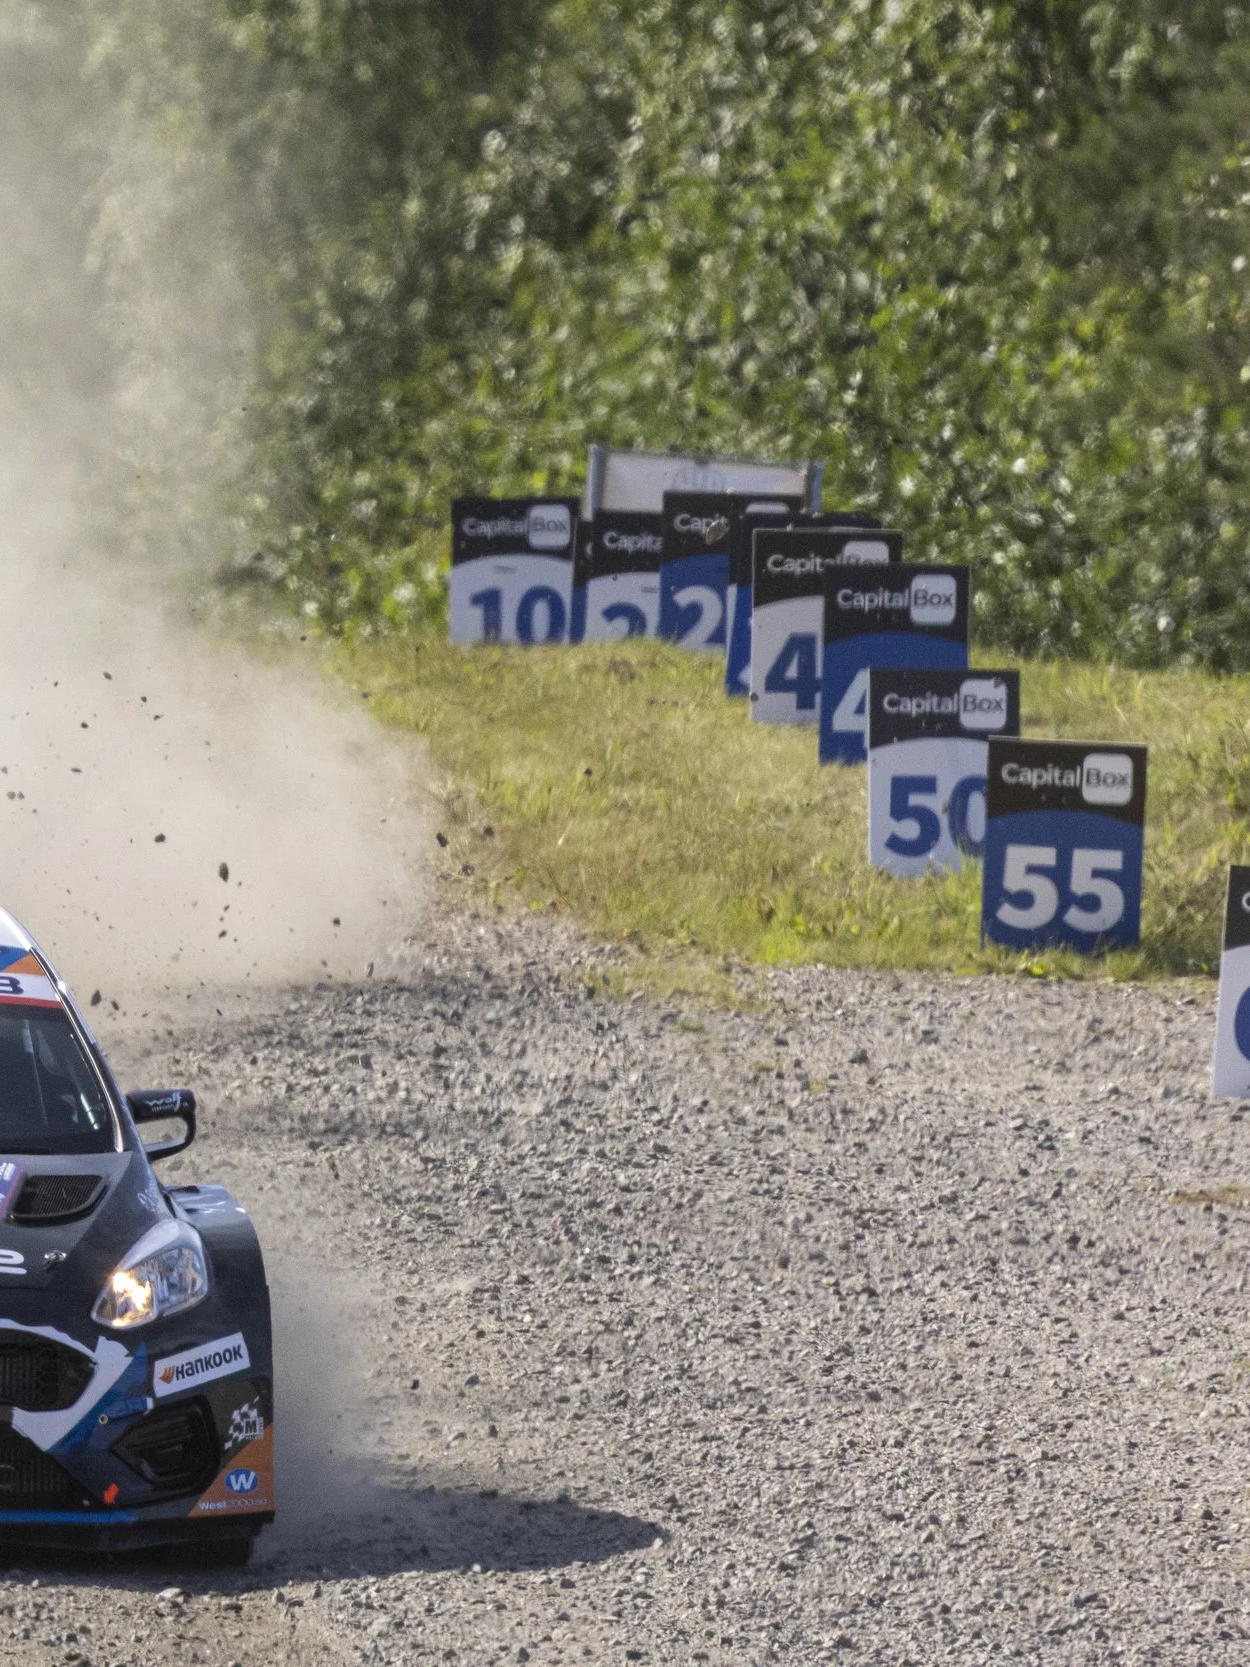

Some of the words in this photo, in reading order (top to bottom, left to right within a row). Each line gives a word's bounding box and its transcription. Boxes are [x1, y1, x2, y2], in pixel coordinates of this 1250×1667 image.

[463, 516, 526, 539] Capital
[532, 515, 568, 534] Box
[673, 513, 729, 536] Capit
[602, 531, 664, 556] Capita
[469, 584, 567, 646] 10
[836, 588, 910, 614] Capital
[914, 590, 954, 608] Box
[673, 585, 724, 648] 2
[764, 632, 823, 710] 4
[832, 667, 870, 750] 4
[882, 692, 958, 718] Capital
[962, 694, 1007, 713] Box
[1001, 762, 1081, 791] Capital
[1086, 768, 1129, 788] Box
[884, 774, 988, 858] 50
[996, 844, 1125, 932] 55
[230, 1471, 256, 1491] W
